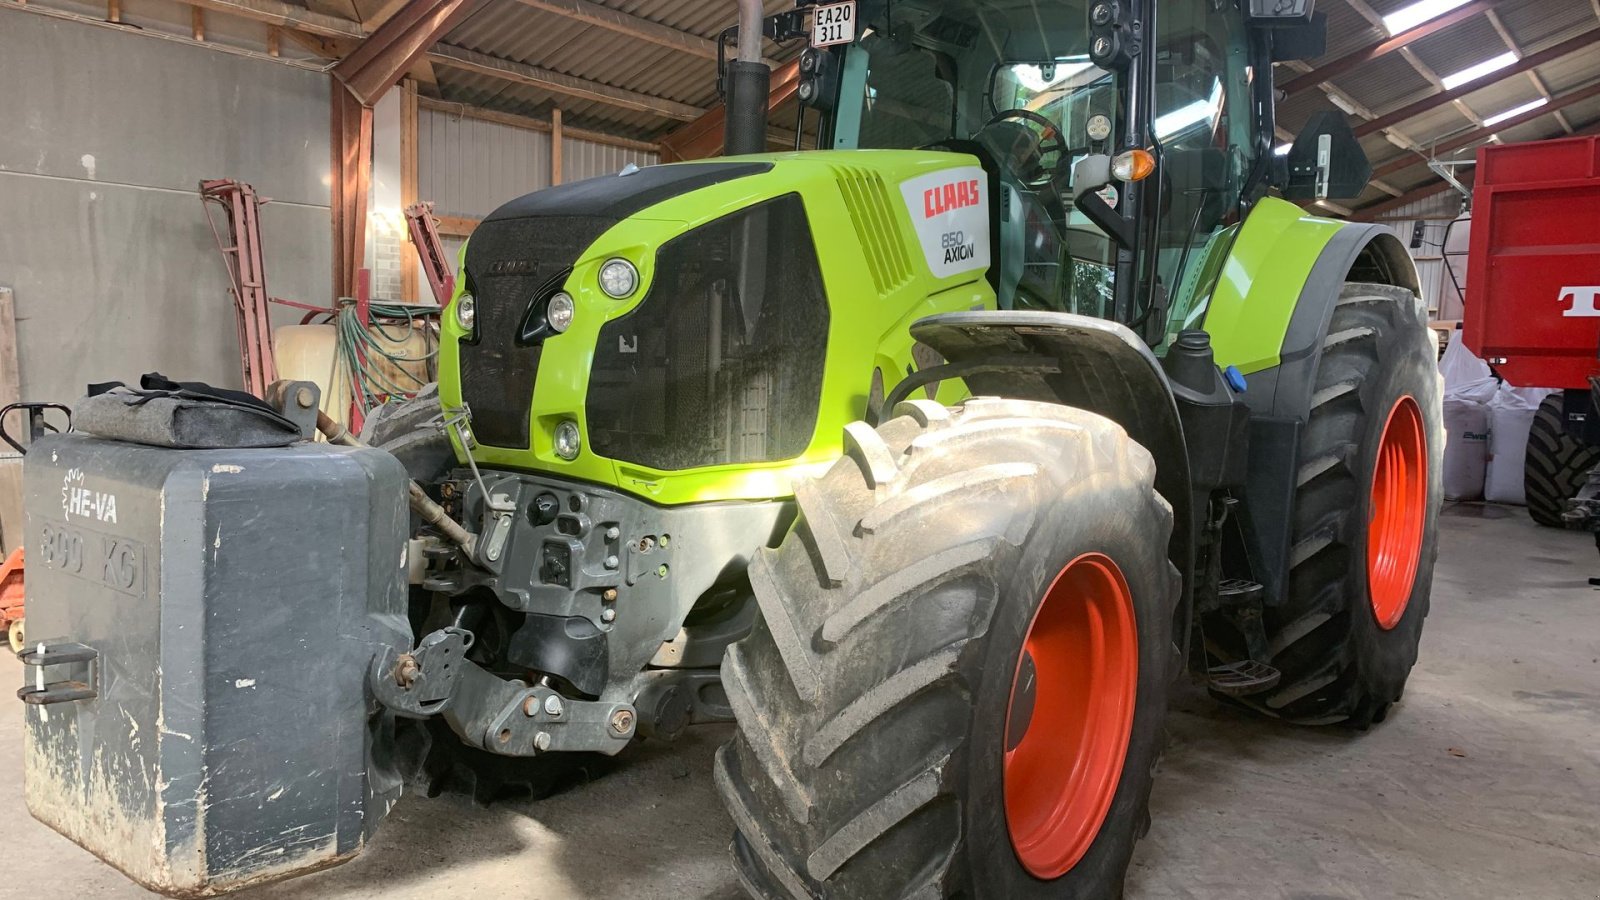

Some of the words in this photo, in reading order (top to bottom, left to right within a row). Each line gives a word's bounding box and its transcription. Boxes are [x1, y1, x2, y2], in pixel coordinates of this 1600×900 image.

[817, 5, 851, 25] EA20
[820, 24, 842, 42] 311
[924, 180, 979, 219] CLAAS
[941, 230, 964, 249] 850
[944, 243, 974, 265] AXION
[69, 487, 118, 524] HE-VA
[102, 536, 138, 590] KG
